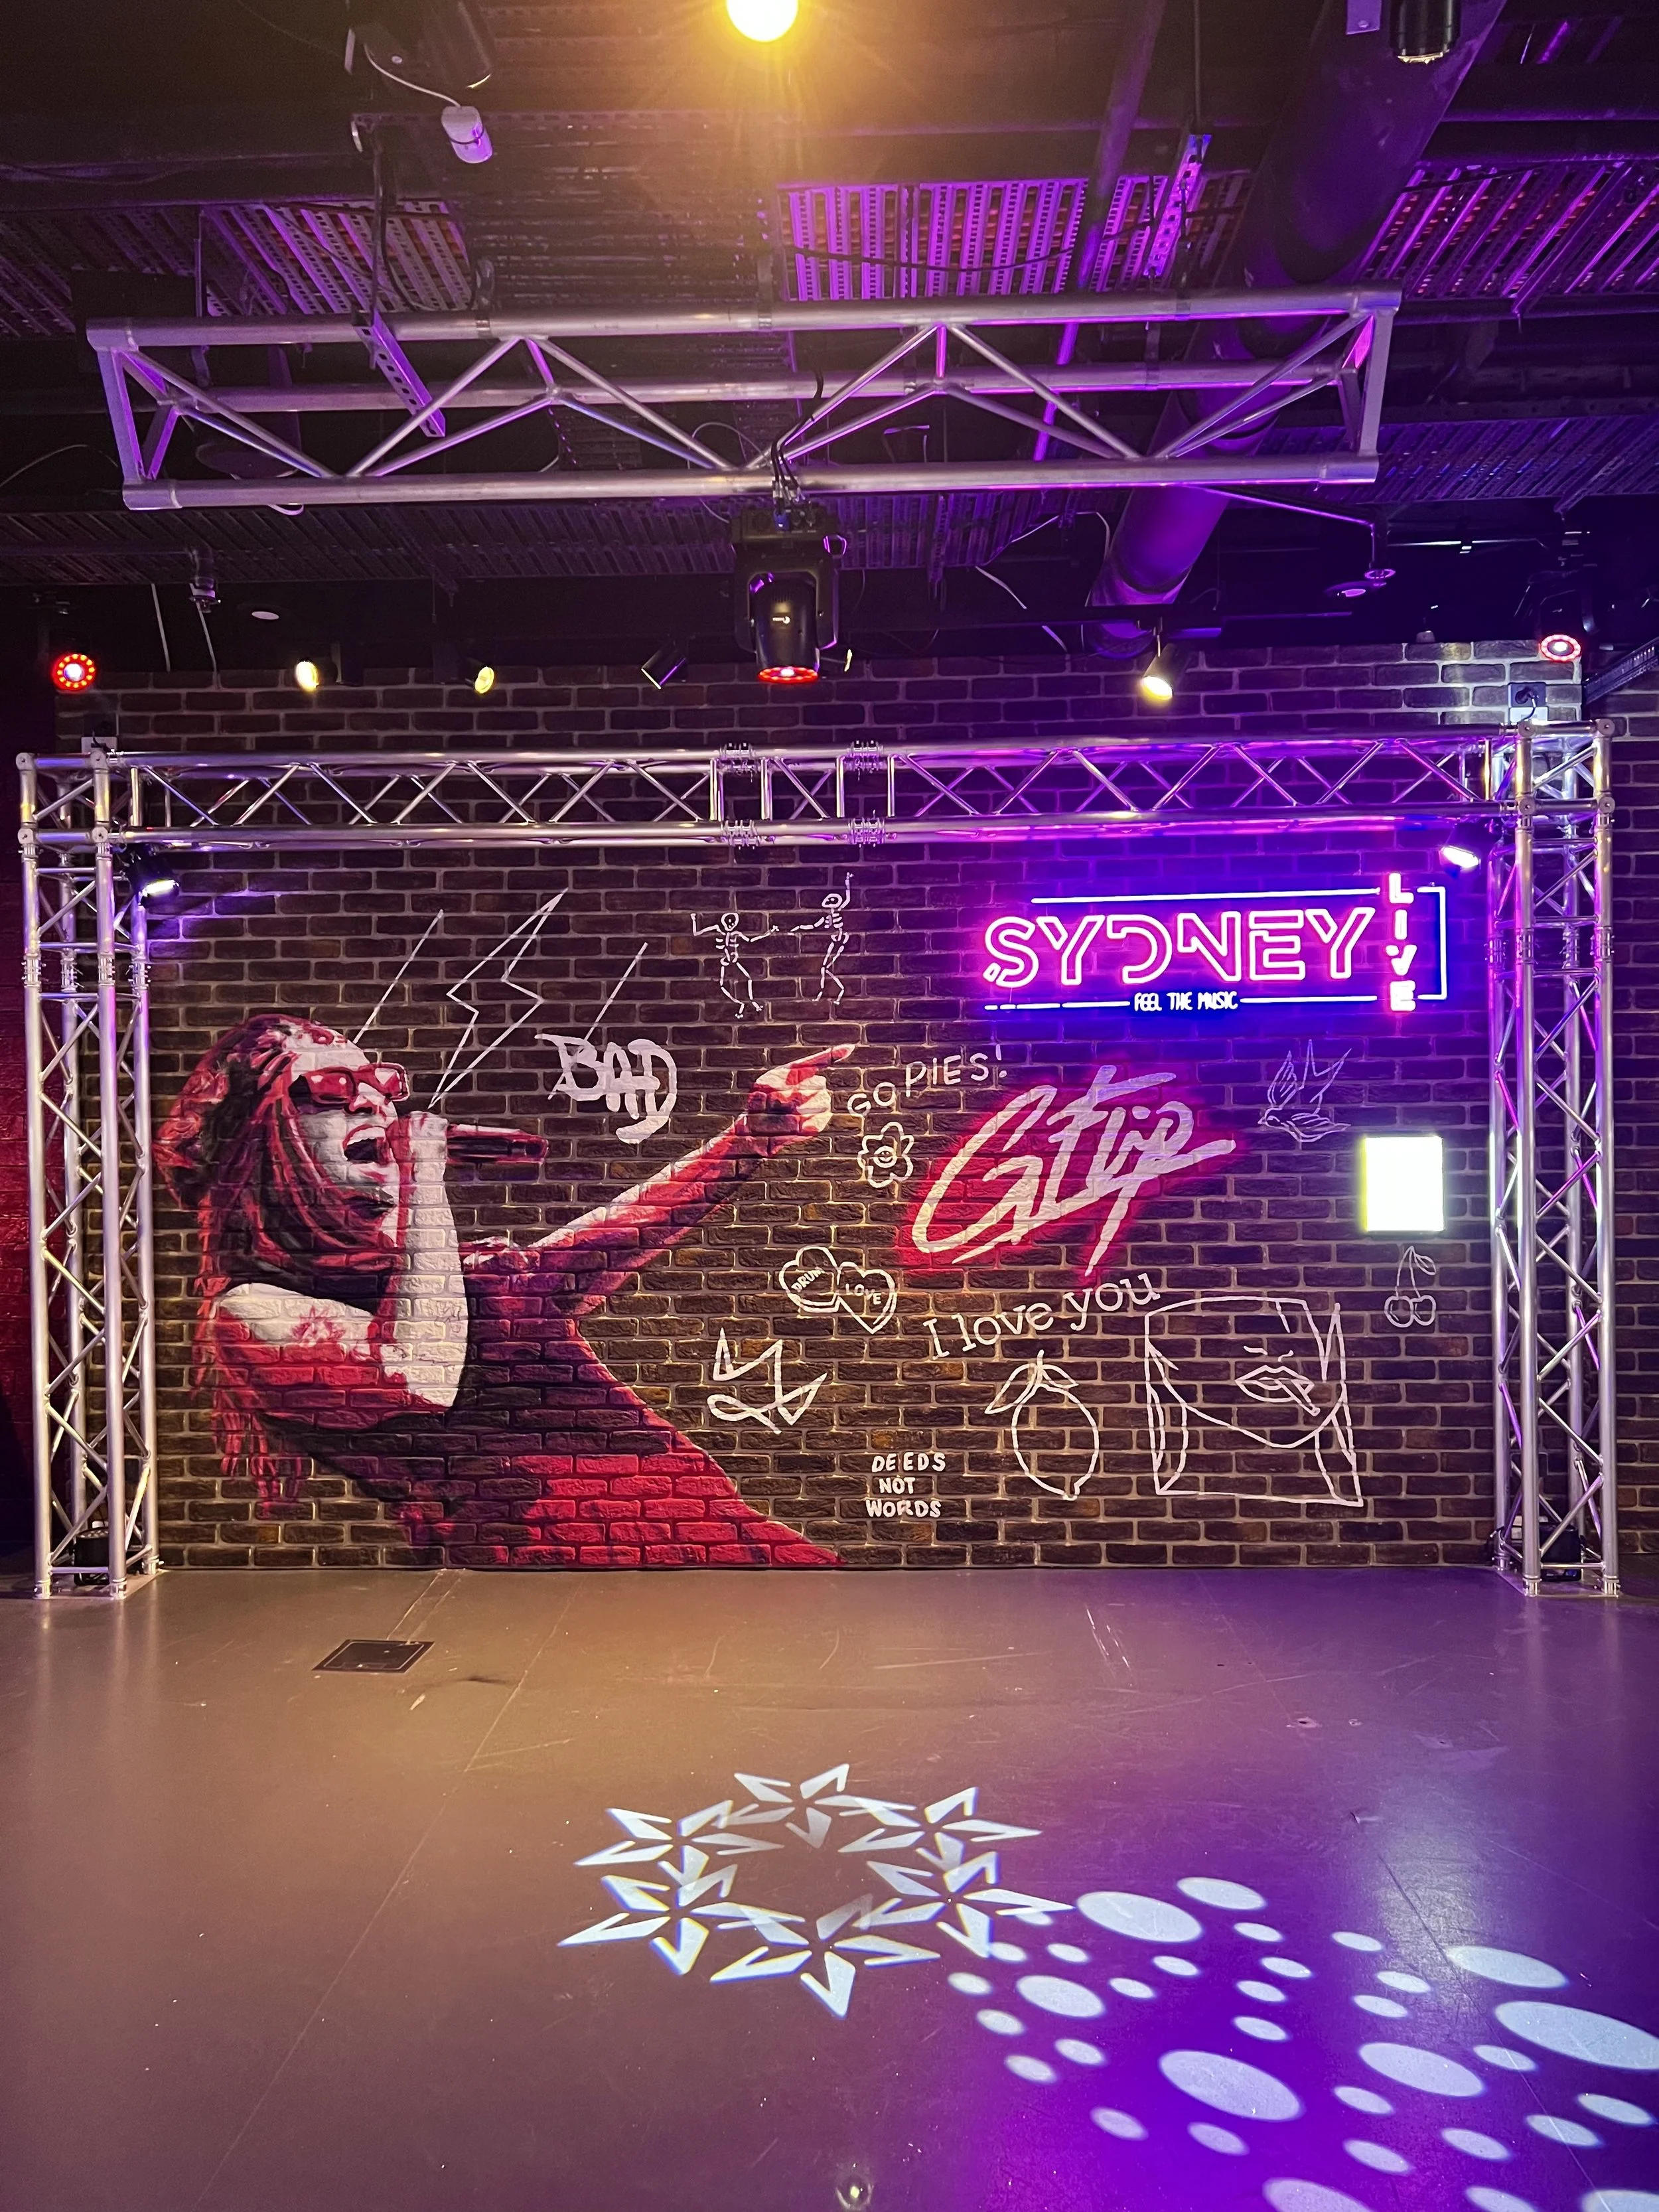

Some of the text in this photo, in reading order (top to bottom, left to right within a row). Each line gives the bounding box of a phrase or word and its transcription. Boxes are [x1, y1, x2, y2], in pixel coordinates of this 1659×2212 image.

[983, 907, 1376, 988] SYDNEY
[1385, 872, 1417, 1011] LIVE
[1134, 990, 1238, 1011] FEEL THE MUSIC
[847, 1043, 1007, 1118] GO PIES!
[791, 1266, 826, 1293] DRUM
[845, 1283, 882, 1305] LOVE
[922, 1272, 1161, 1361] I love you
[871, 1452, 946, 1473] DEEDS
[879, 1477, 916, 1495] NOT
[865, 1499, 942, 1518] WORDS
